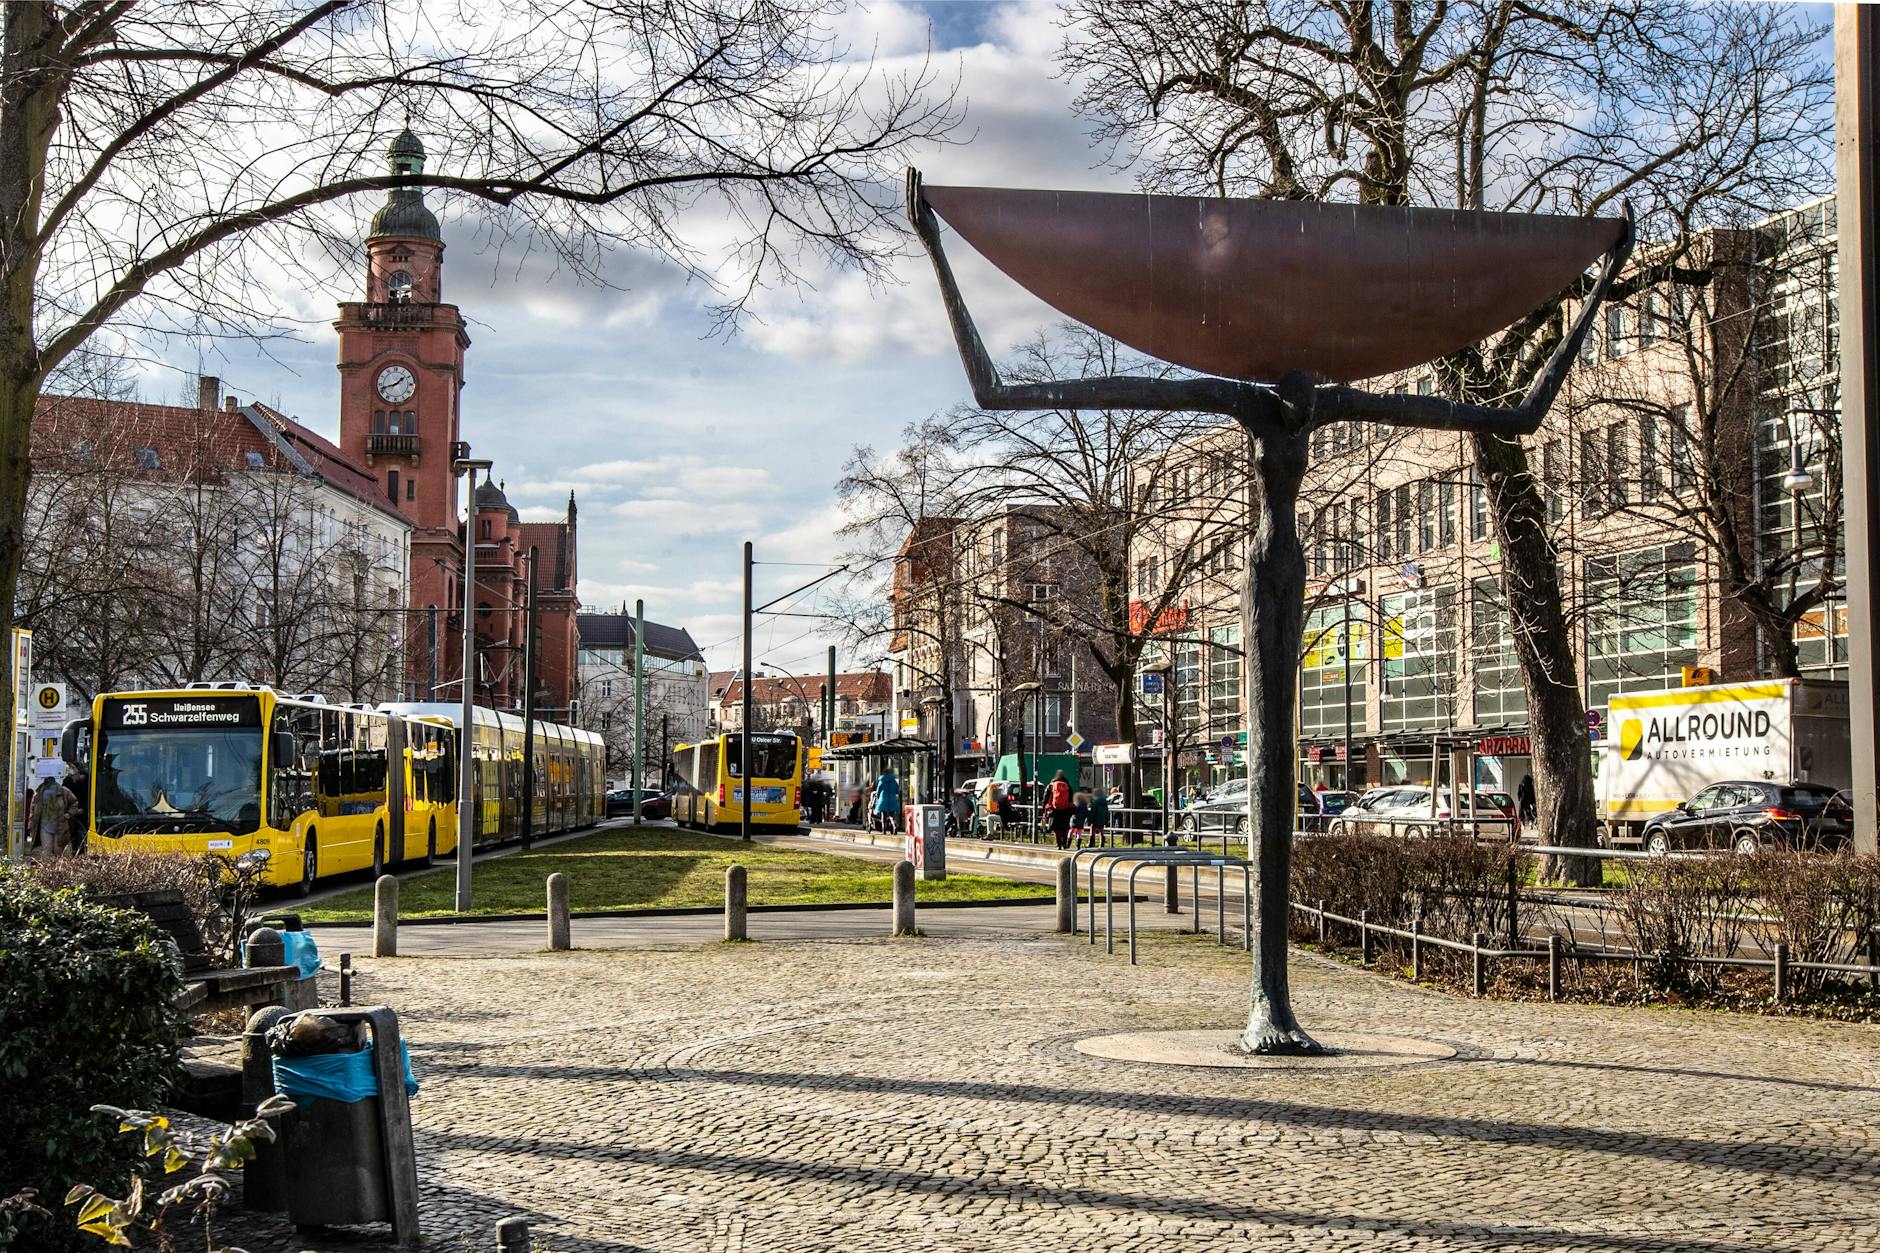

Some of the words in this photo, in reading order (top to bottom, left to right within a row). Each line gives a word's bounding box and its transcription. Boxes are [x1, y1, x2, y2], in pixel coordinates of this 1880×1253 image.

[44, 692, 54, 704] H
[174, 703, 216, 712] Weißensee
[122, 704, 148, 725] 255
[150, 711, 240, 723] Schwarzelfenweg
[1647, 710, 1771, 743] ALLROUND
[1647, 746, 1771, 761] AUTOVERMIETUNG
